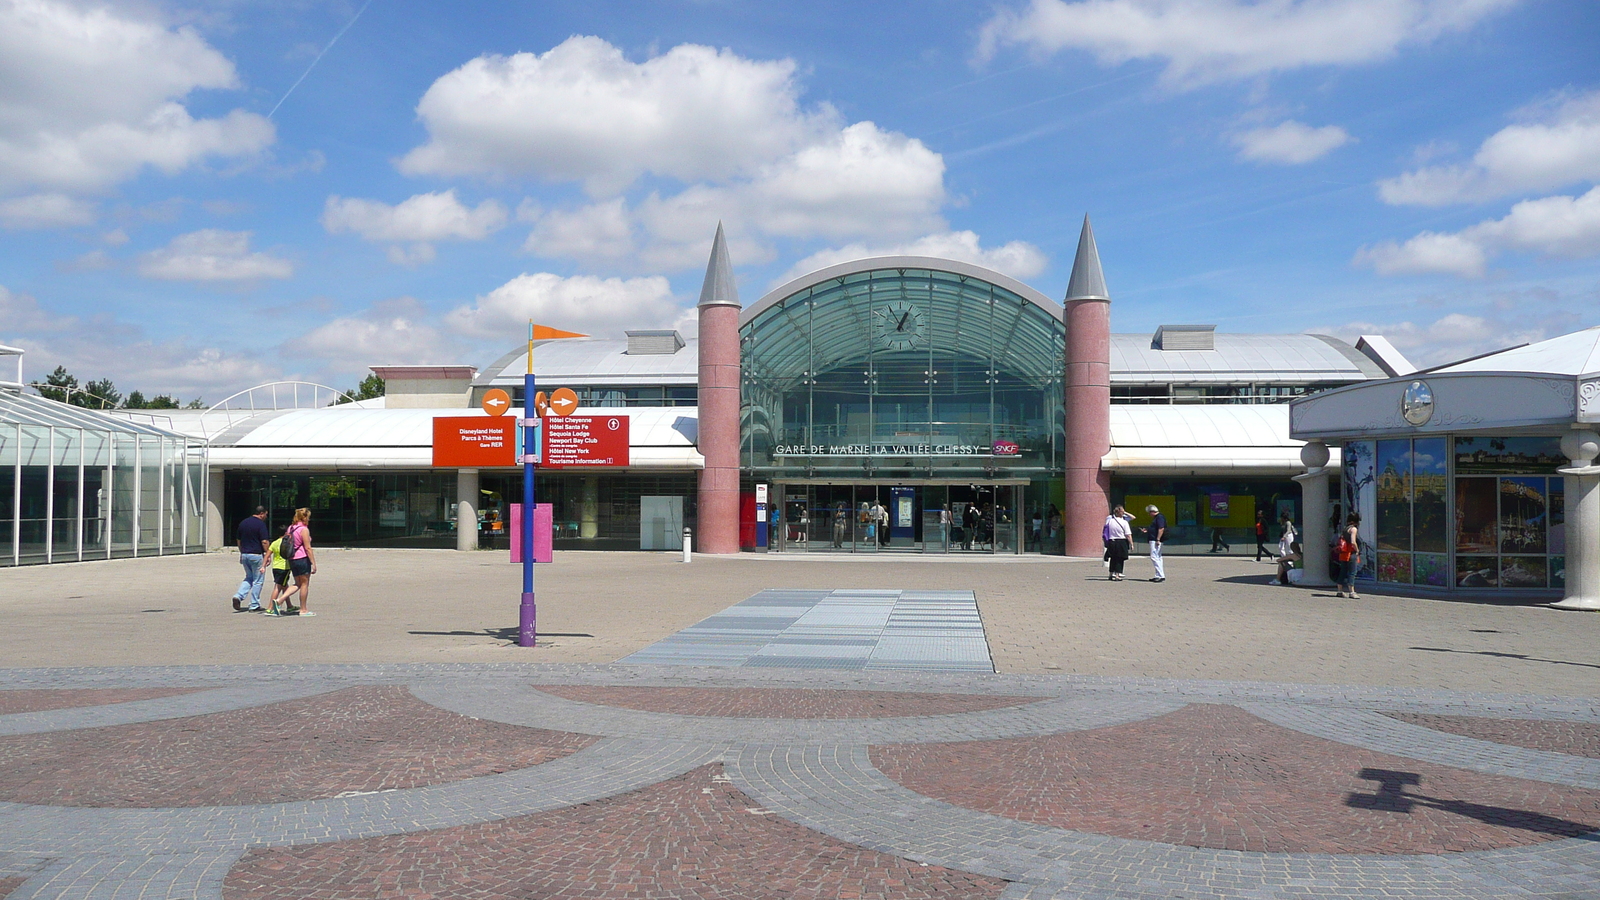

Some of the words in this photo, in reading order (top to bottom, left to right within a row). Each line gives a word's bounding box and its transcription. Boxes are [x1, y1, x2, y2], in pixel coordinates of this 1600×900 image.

[775, 445, 806, 454] GARE
[811, 445, 824, 454] DE
[829, 445, 869, 454] MARNE
[875, 445, 888, 454] LA
[892, 442, 930, 454] VALLÉE
[935, 445, 980, 454] CHESSY
[995, 444, 1018, 453] SNCF
